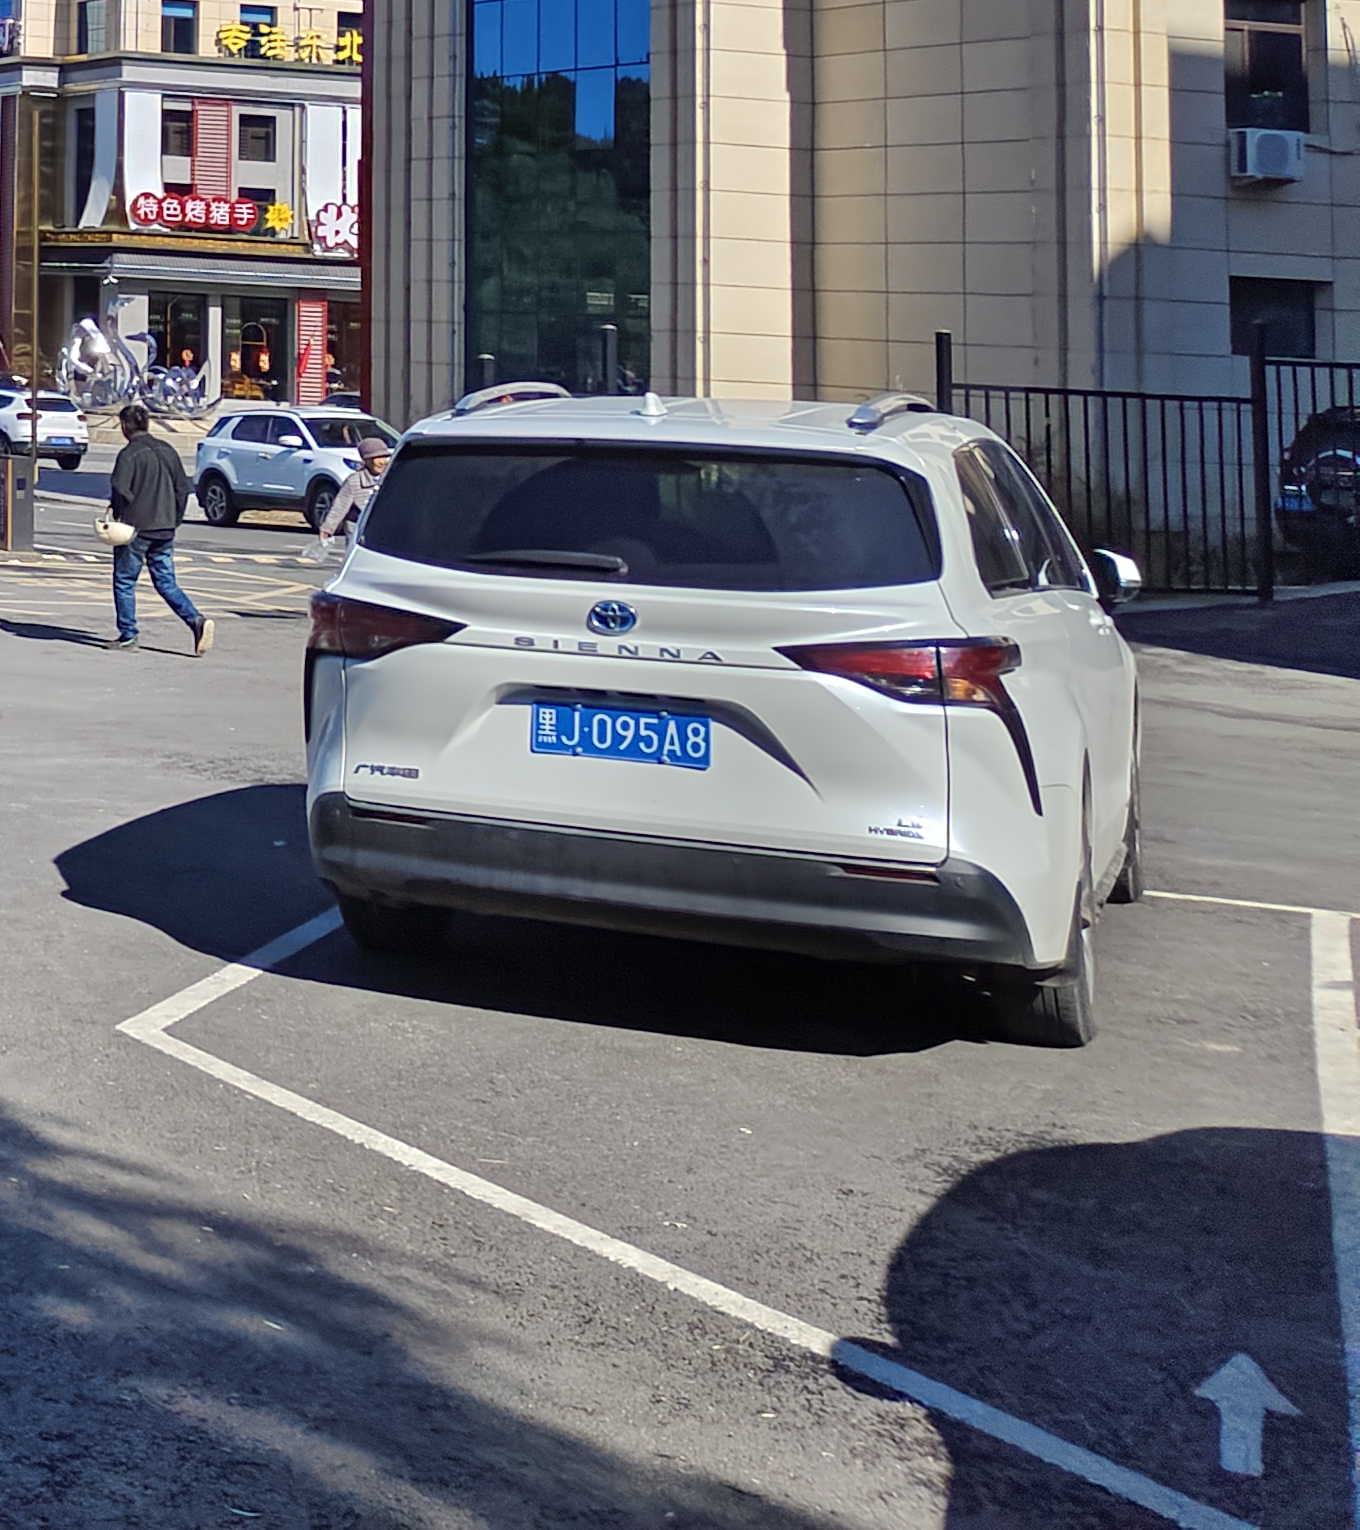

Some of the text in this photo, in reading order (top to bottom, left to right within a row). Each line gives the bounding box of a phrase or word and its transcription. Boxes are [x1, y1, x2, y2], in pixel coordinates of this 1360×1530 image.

[218, 21, 363, 63] 专注东北
[137, 196, 256, 226] 特色烤猪手
[514, 636, 723, 662] SIENNA
